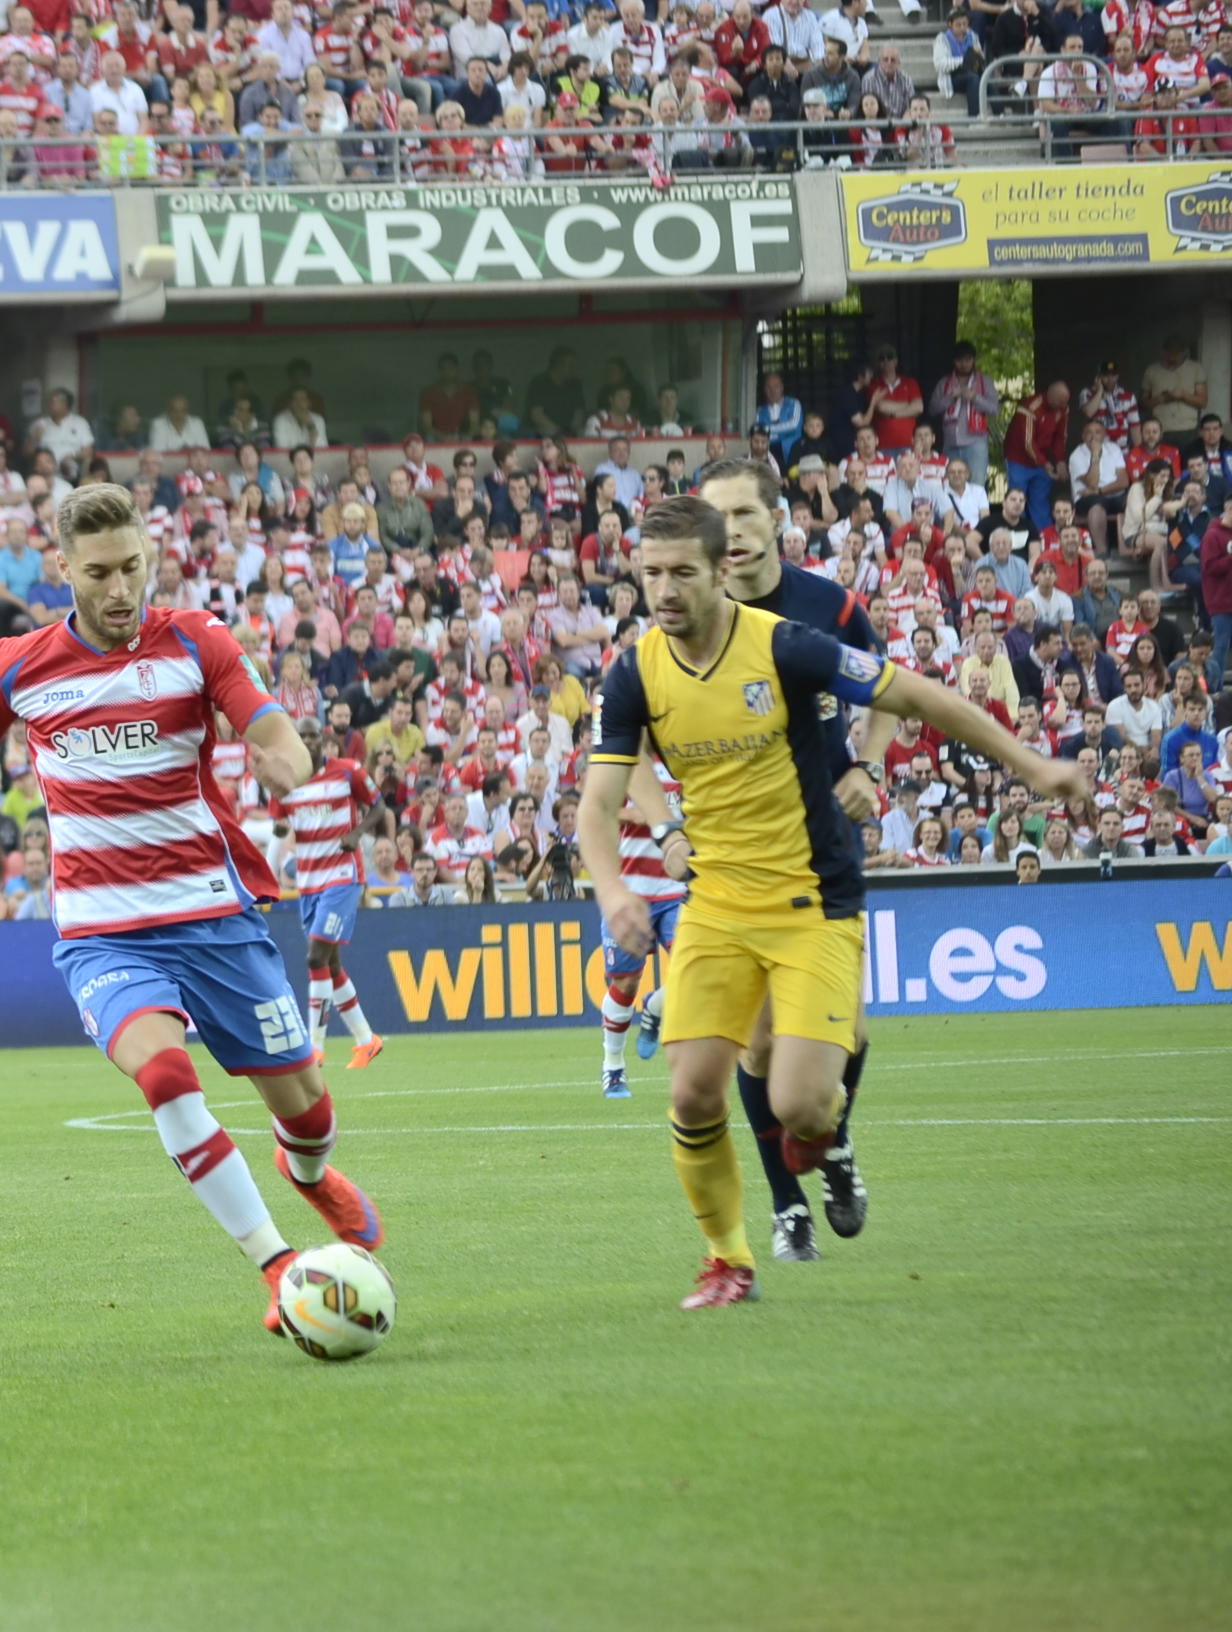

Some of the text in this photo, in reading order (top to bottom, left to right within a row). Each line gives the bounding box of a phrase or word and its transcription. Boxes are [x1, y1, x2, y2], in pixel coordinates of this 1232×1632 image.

[170, 194, 236, 213] OBRA
[239, 192, 298, 212] CIVIL
[327, 189, 406, 211] OBRAS
[418, 186, 581, 209] INDUSTRIALES
[981, 177, 1145, 203] el taller tienda
[995, 201, 1137, 230] para su coche
[170, 200, 793, 288] MARACOF
[888, 222, 942, 244] Auto
[994, 240, 1143, 262] centersautogranada.com
[52, 722, 159, 759] SOLVER
